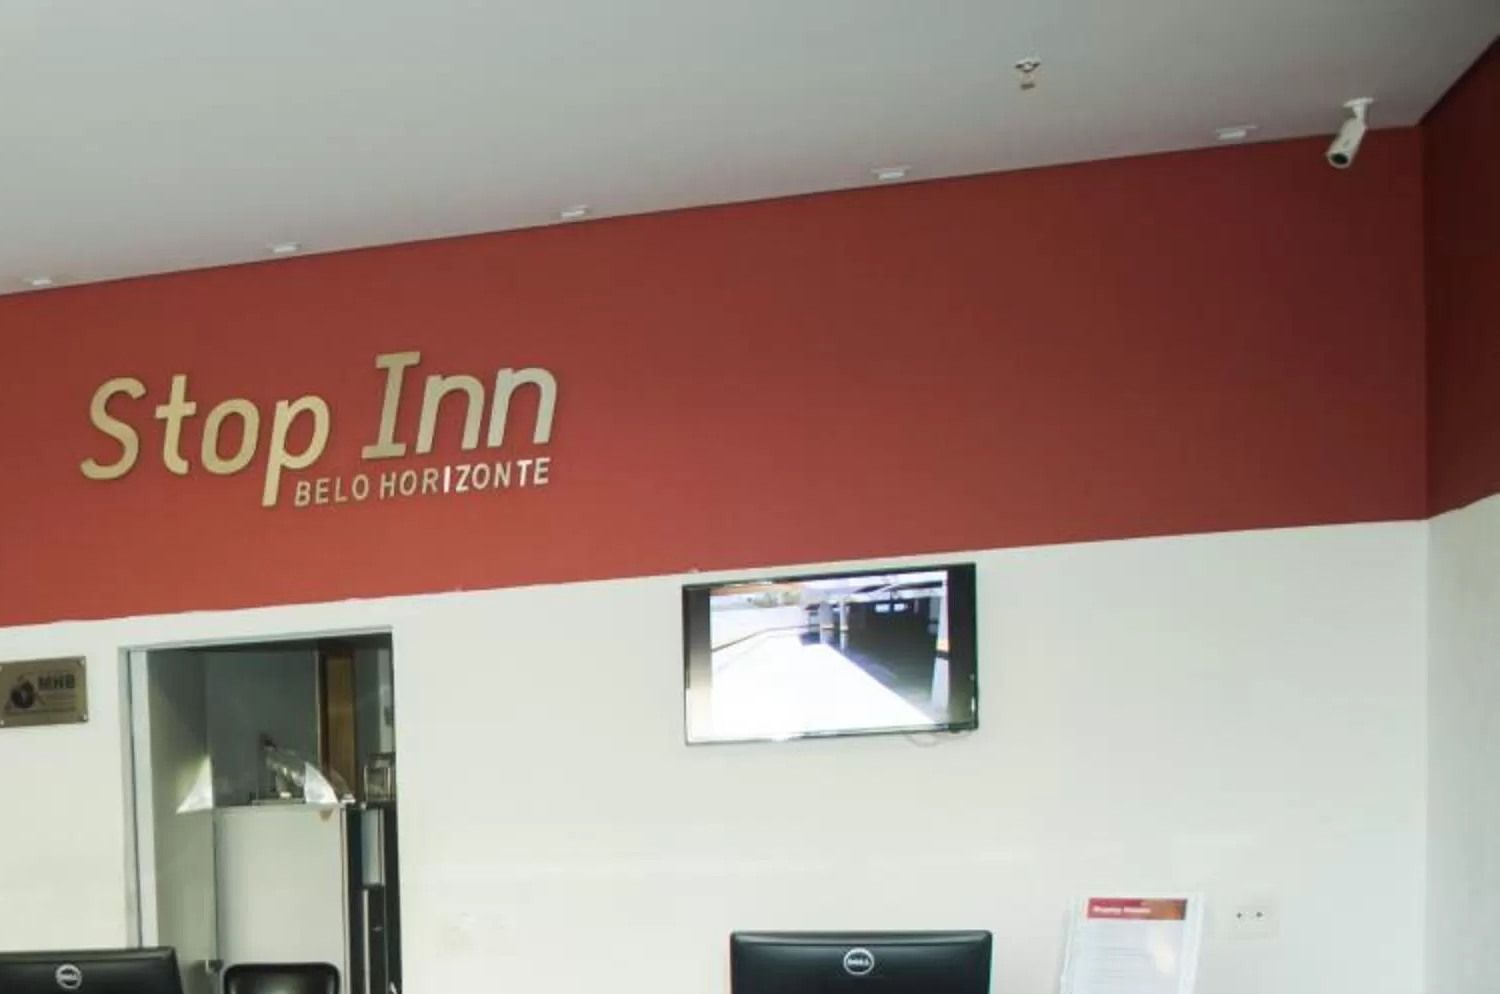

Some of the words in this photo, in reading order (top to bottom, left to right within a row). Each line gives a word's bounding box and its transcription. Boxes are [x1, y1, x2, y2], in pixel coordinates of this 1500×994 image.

[79, 373, 331, 508] Stop
[361, 351, 559, 460] Inn
[294, 473, 369, 507] BELO
[380, 457, 552, 498] HORIZONTE
